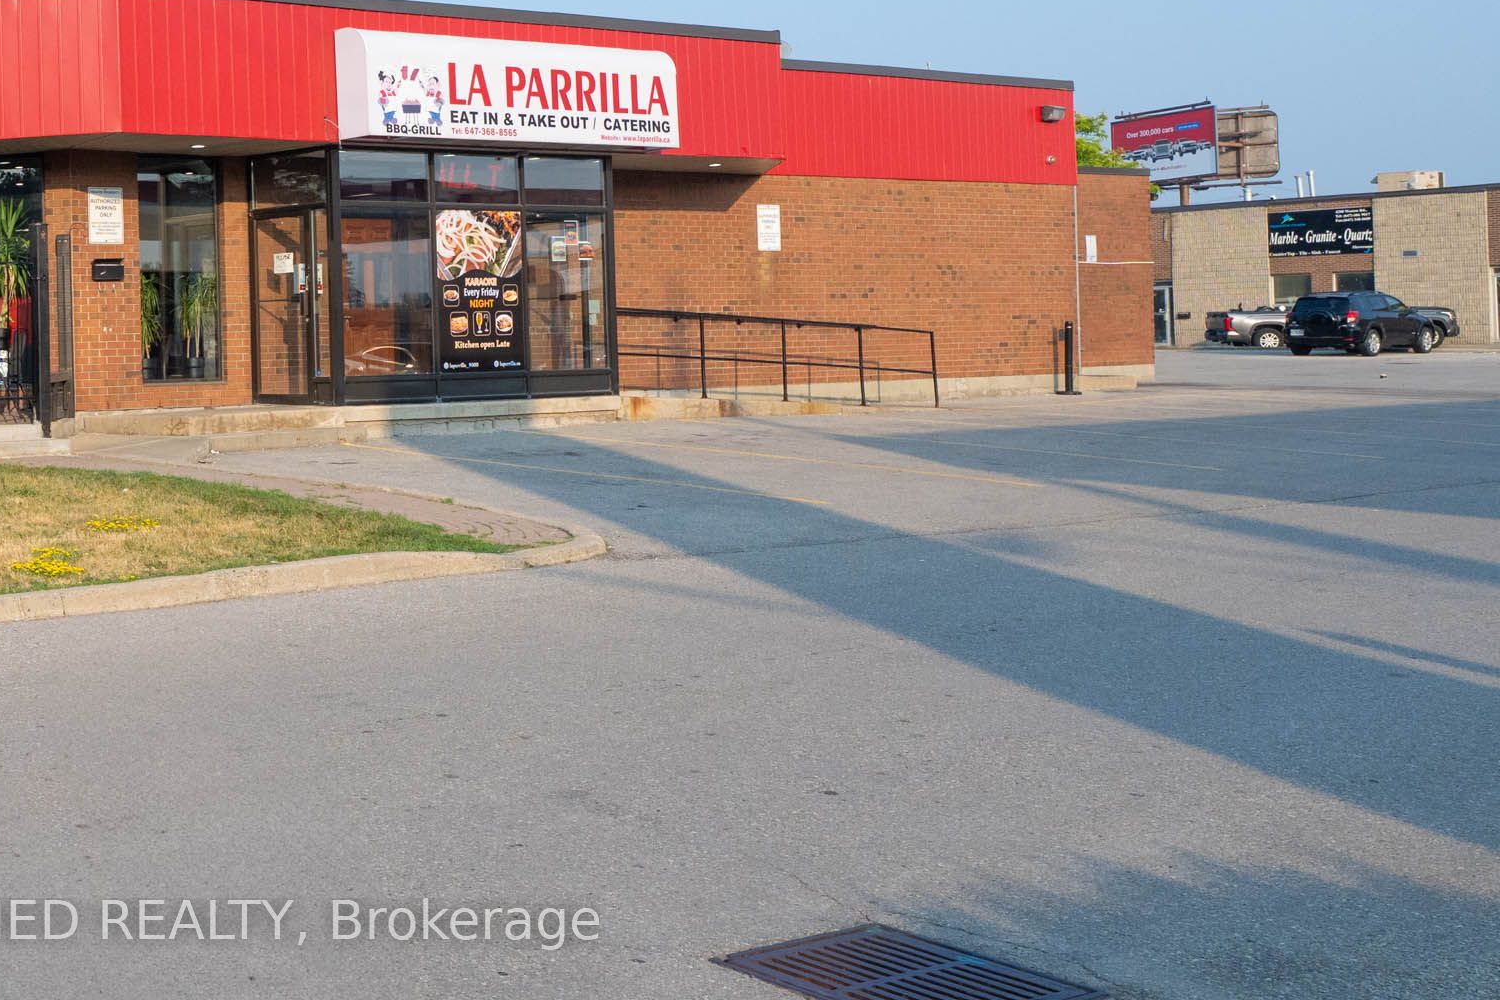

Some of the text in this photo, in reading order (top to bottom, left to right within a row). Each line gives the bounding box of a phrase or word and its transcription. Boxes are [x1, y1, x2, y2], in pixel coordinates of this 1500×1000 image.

[448, 62, 669, 116] LA PARRILLA
[450, 110, 478, 125] EAT
[483, 112, 499, 125] IN
[503, 113, 514, 126] &
[518, 114, 555, 128] TAKE
[560, 116, 589, 130] OUT
[604, 118, 670, 133] CATERING
[386, 124, 442, 136] BBQ-GRILL
[1270, 231, 1298, 245] Marble
[1306, 230, 1336, 244] Granite
[1344, 228, 1373, 244] Quartz
[464, 278, 498, 287] KARAOKE
[464, 288, 500, 298] Every Friday
[469, 299, 494, 308] NIGHT
[454, 340, 510, 350] Kitchen open Late
